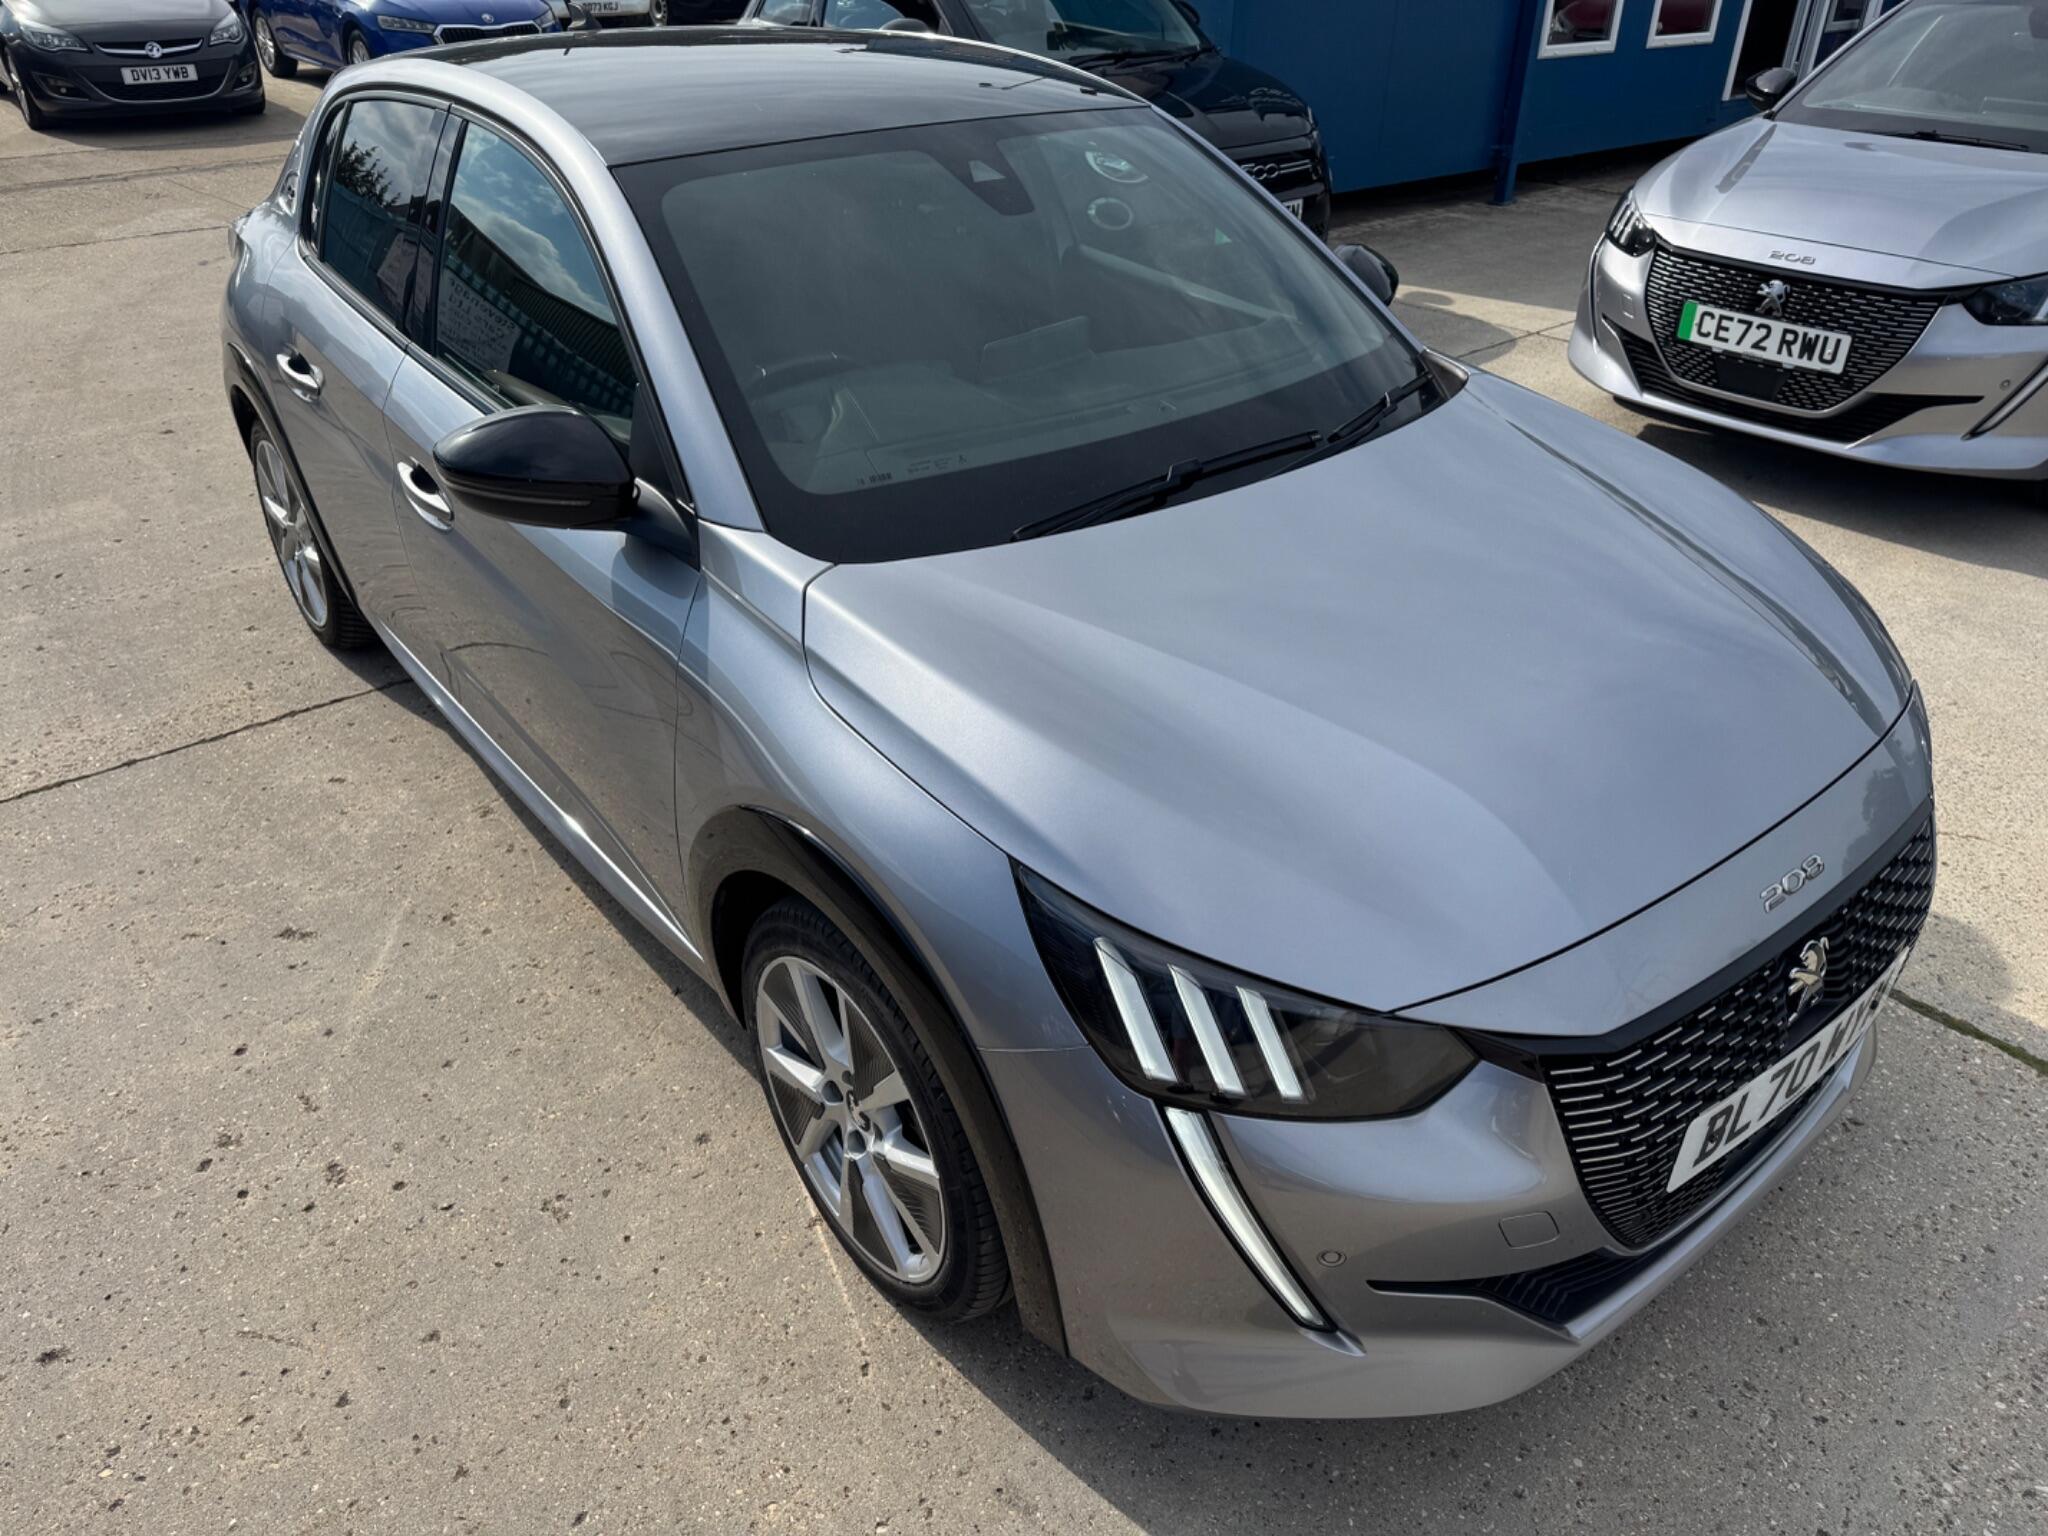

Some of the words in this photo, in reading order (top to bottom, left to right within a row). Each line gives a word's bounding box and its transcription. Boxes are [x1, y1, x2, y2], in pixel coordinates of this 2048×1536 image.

[130, 68, 161, 81] DV13
[163, 66, 189, 79] YWB
[1768, 250, 1816, 265] 208
[1696, 309, 1773, 352] CE72
[1776, 327, 1842, 366] RWU
[1760, 853, 1825, 914] 208
[1692, 1040, 1821, 1169] BL70
